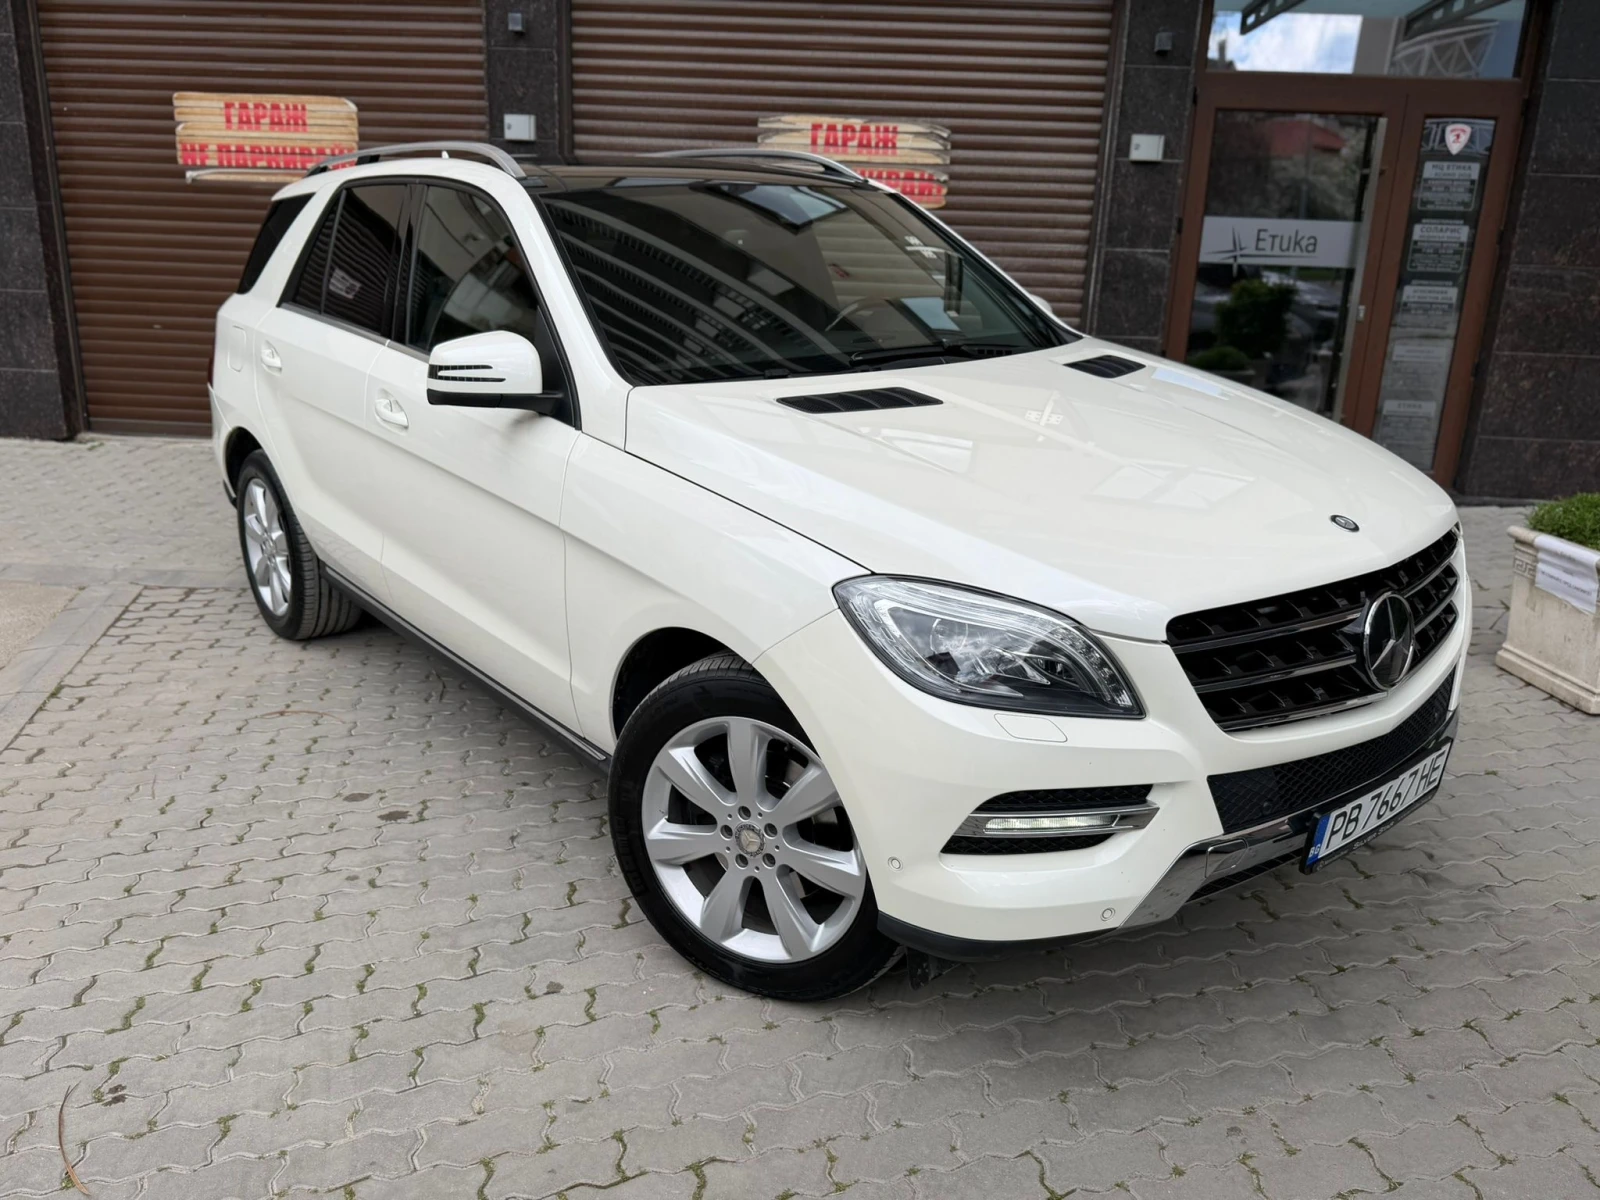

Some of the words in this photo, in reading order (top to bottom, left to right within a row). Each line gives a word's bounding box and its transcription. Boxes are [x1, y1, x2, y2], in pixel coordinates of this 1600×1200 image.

[224, 101, 309, 132] ГАРАЖ
[810, 123, 898, 155] ГАРАЖ
[181, 143, 208, 167] НЕ
[1308, 843, 1321, 858] BG
